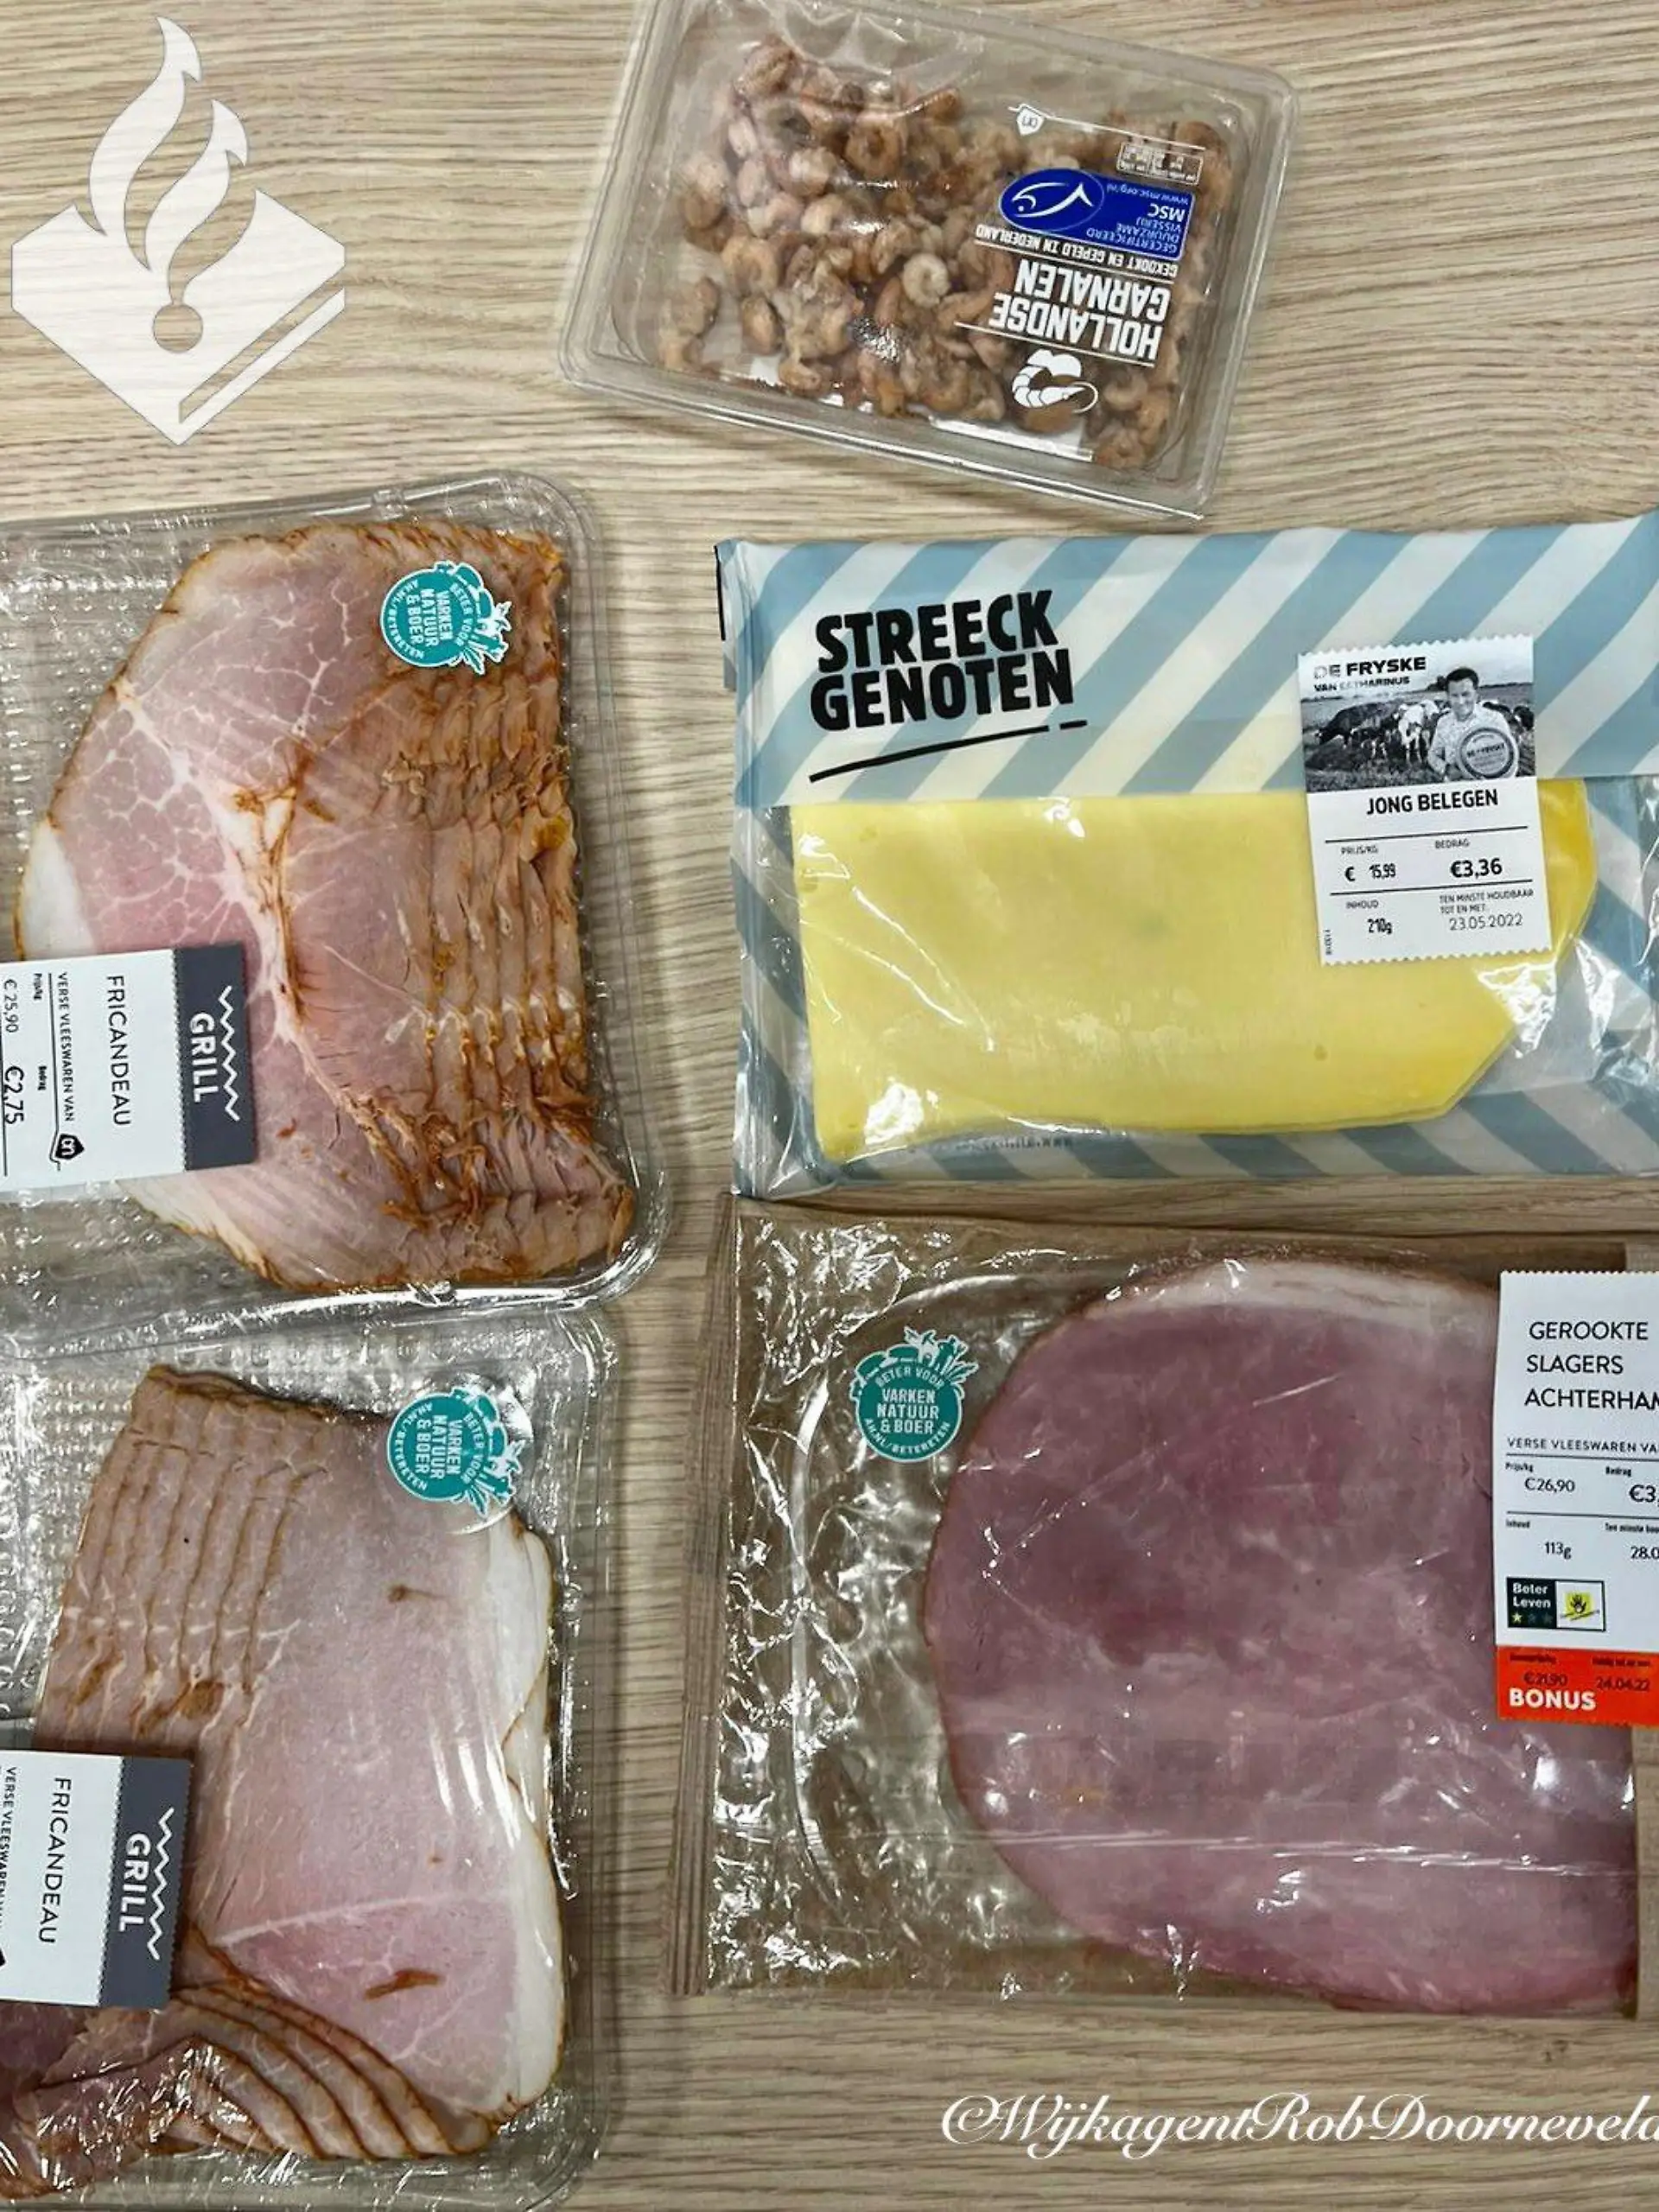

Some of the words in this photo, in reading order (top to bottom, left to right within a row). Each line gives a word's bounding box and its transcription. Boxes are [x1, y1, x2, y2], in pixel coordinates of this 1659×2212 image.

[1147, 204, 1185, 222] MSC
[976, 224, 1040, 249] NEDERLAND
[1086, 227, 1177, 253] GECERTIFICEERD
[1116, 223, 1179, 243] DUURZAME
[1043, 239, 1057, 252] IN
[1062, 244, 1105, 263] GEPELD
[1109, 252, 1124, 266] EN
[1127, 256, 1179, 278] GEKOOKT
[1014, 259, 1171, 322] GARNALEN
[988, 292, 1162, 359] HOLLANDSE
[407, 607, 423, 645] BOER
[420, 588, 440, 646] NATUUR
[436, 590, 453, 640] VARKEN
[815, 589, 1058, 673] STREECK
[1313, 664, 1341, 679] DE
[1346, 657, 1427, 677] FRYSKE
[810, 648, 1074, 732] GENOTEN
[1367, 796, 1413, 815] JONG
[1418, 789, 1498, 813] BELEGEN
[1434, 838, 1471, 849] BEDRAG
[1344, 867, 1355, 881] €
[1450, 858, 1503, 879] €3,36
[1345, 899, 1379, 909] INHOUD
[1457, 892, 1485, 902] MINSTE
[1457, 905, 1467, 913] EN
[1449, 913, 1522, 931] 23.05.2022
[57, 971, 70, 1011] VERSE
[59, 1013, 73, 1091] VLEESWAREN
[106, 975, 131, 1126] FRICANDEAU
[190, 1013, 219, 1103] GRILL
[3, 1065, 24, 1125] €2,75
[63, 1092, 75, 1122] VAN
[1529, 1321, 1649, 1340] GEROOKTE
[1527, 1354, 1624, 1374] SLAGERS
[881, 1389, 936, 1404] VARKEN
[877, 1403, 940, 1420] NATUUR
[880, 1420, 890, 1433] &
[893, 1420, 935, 1434] BOER
[415, 1433, 431, 1474] BOER
[430, 1414, 448, 1479] NATUUR
[446, 1420, 462, 1475] VARKEN
[1507, 1438, 1547, 1450] VERSE
[1551, 1439, 1636, 1452] VLEESWAREN
[1640, 1441, 1659, 1453] VA
[1524, 1477, 1575, 1493] €26,90
[1544, 1541, 1572, 1560] 113g
[1513, 1597, 1551, 1608] Leven
[1510, 1688, 1596, 1711] BONUS
[3, 1766, 16, 1808] VERSE
[38, 1777, 72, 1944] FRICANDEAU
[119, 1834, 151, 1932] GRILL
